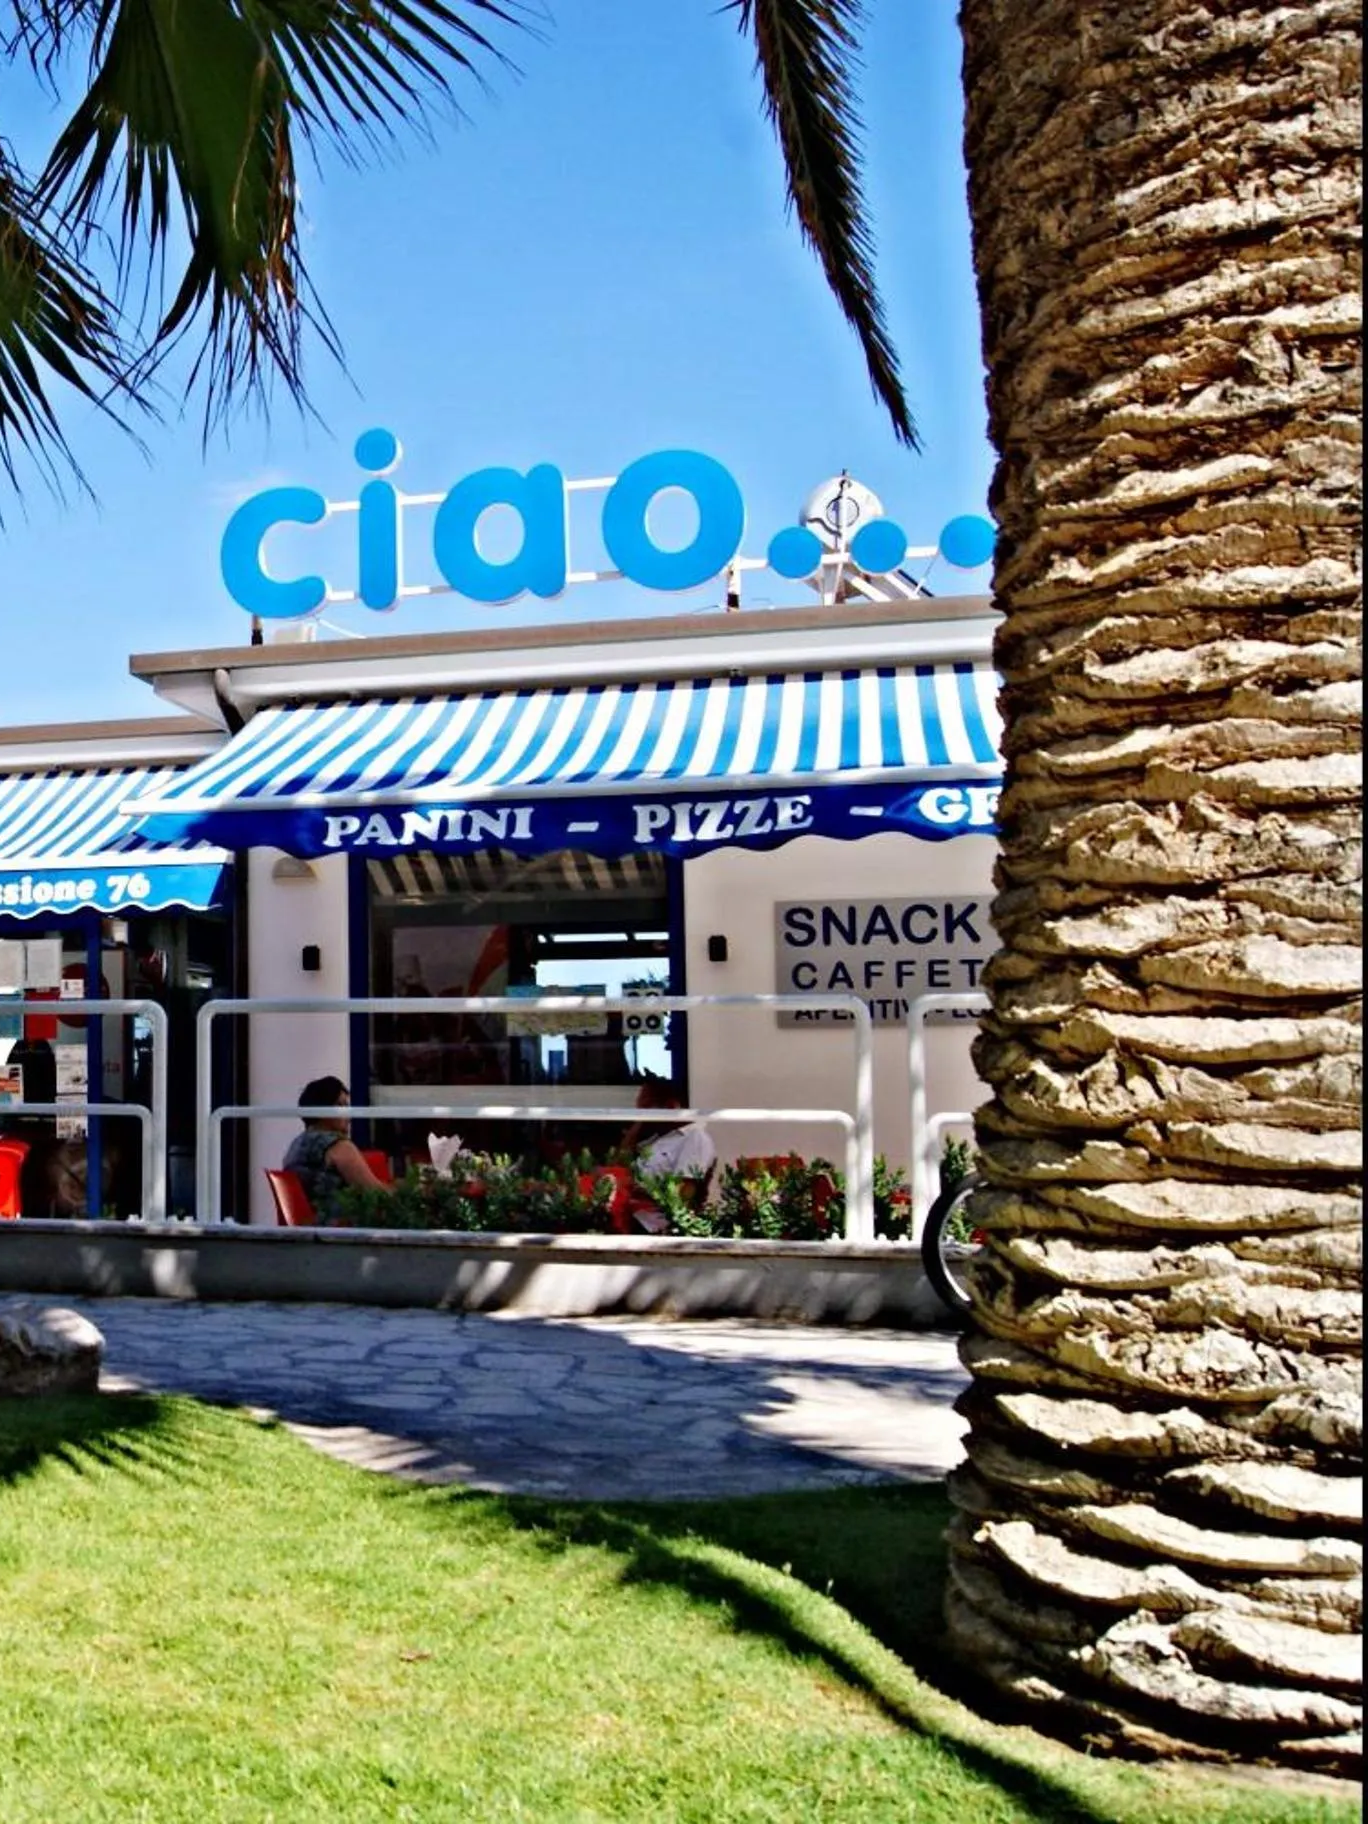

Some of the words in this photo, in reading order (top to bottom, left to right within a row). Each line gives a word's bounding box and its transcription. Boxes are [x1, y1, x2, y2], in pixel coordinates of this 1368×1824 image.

[323, 807, 534, 847] PANINI
[633, 795, 814, 843] PIZZE
[106, 873, 151, 902] 76
[784, 902, 981, 947] SNACK
[791, 959, 984, 991] CAFFET
